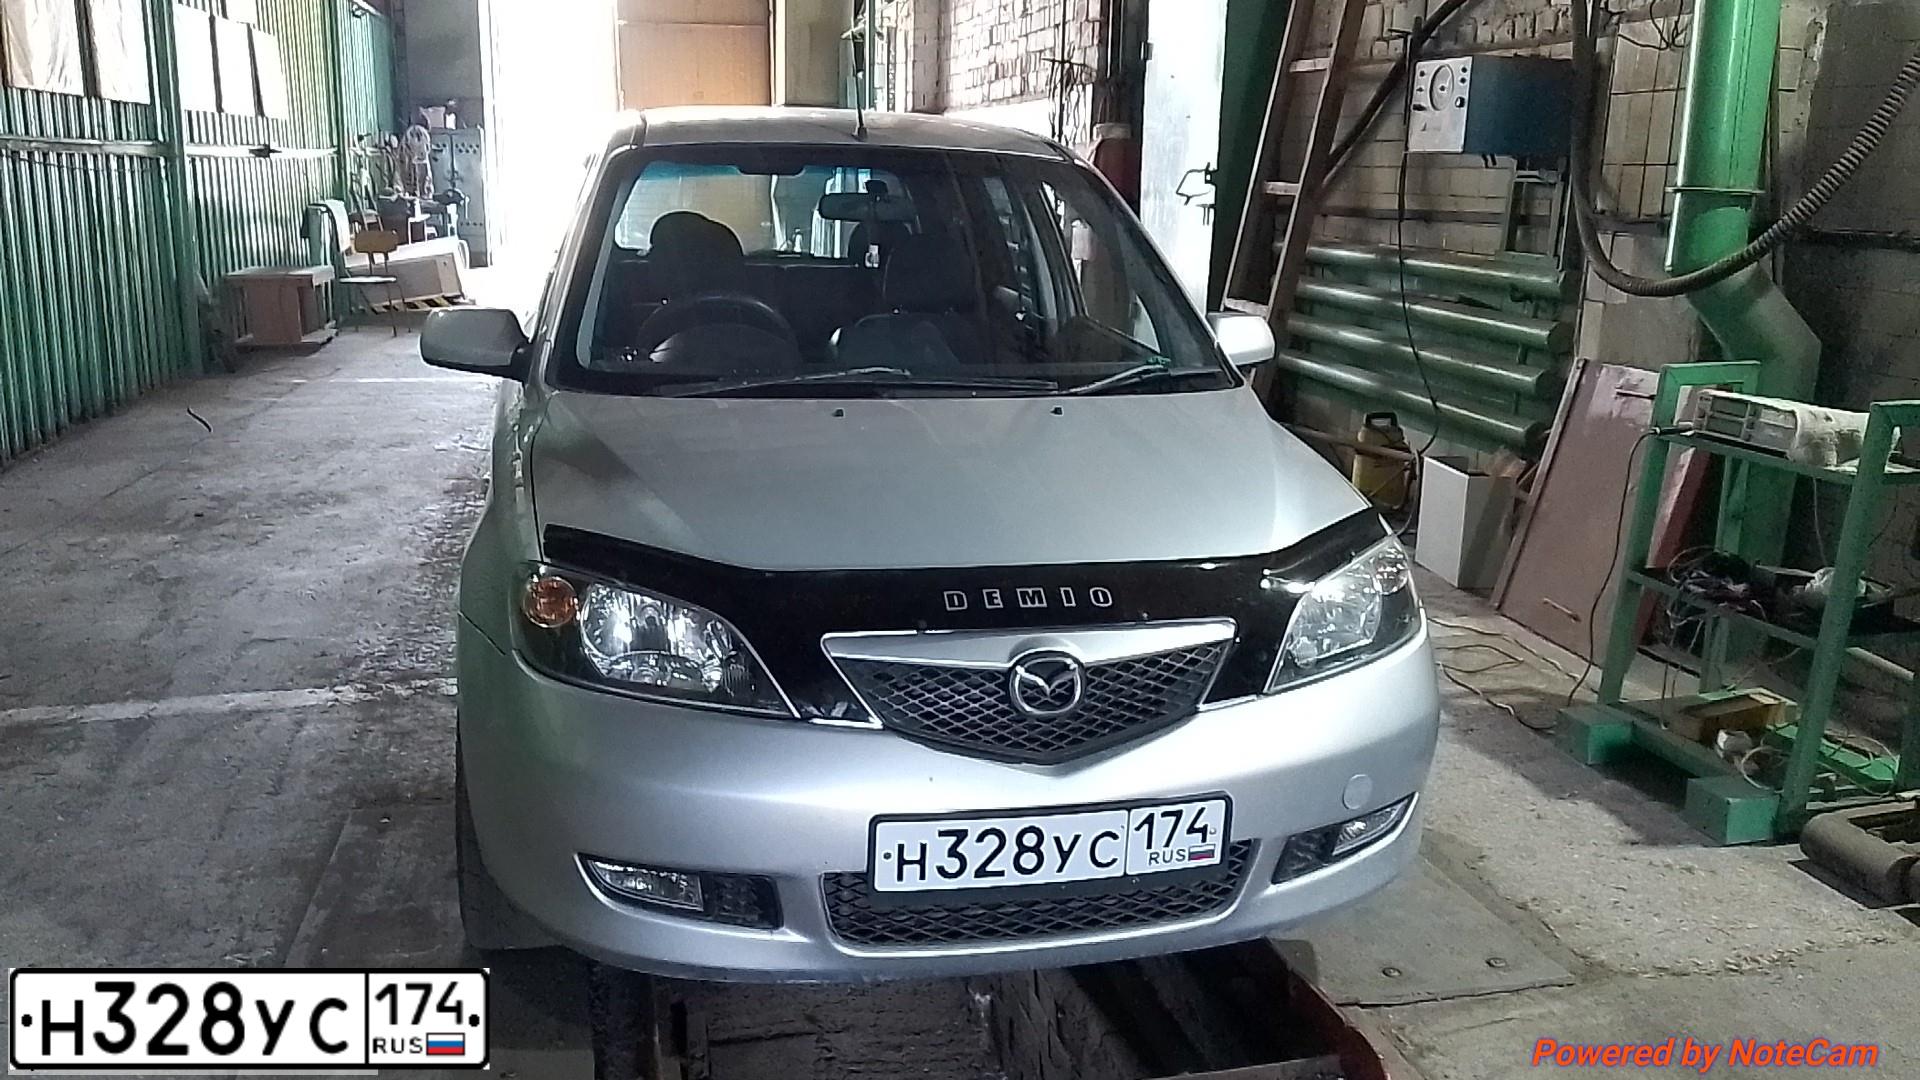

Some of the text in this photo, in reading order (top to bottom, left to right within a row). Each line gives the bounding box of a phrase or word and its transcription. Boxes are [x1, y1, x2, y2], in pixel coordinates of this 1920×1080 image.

[943, 586, 1113, 611] DEMIO
[896, 806, 1209, 882] Н328УС 174
[1148, 848, 1187, 867] RUS
